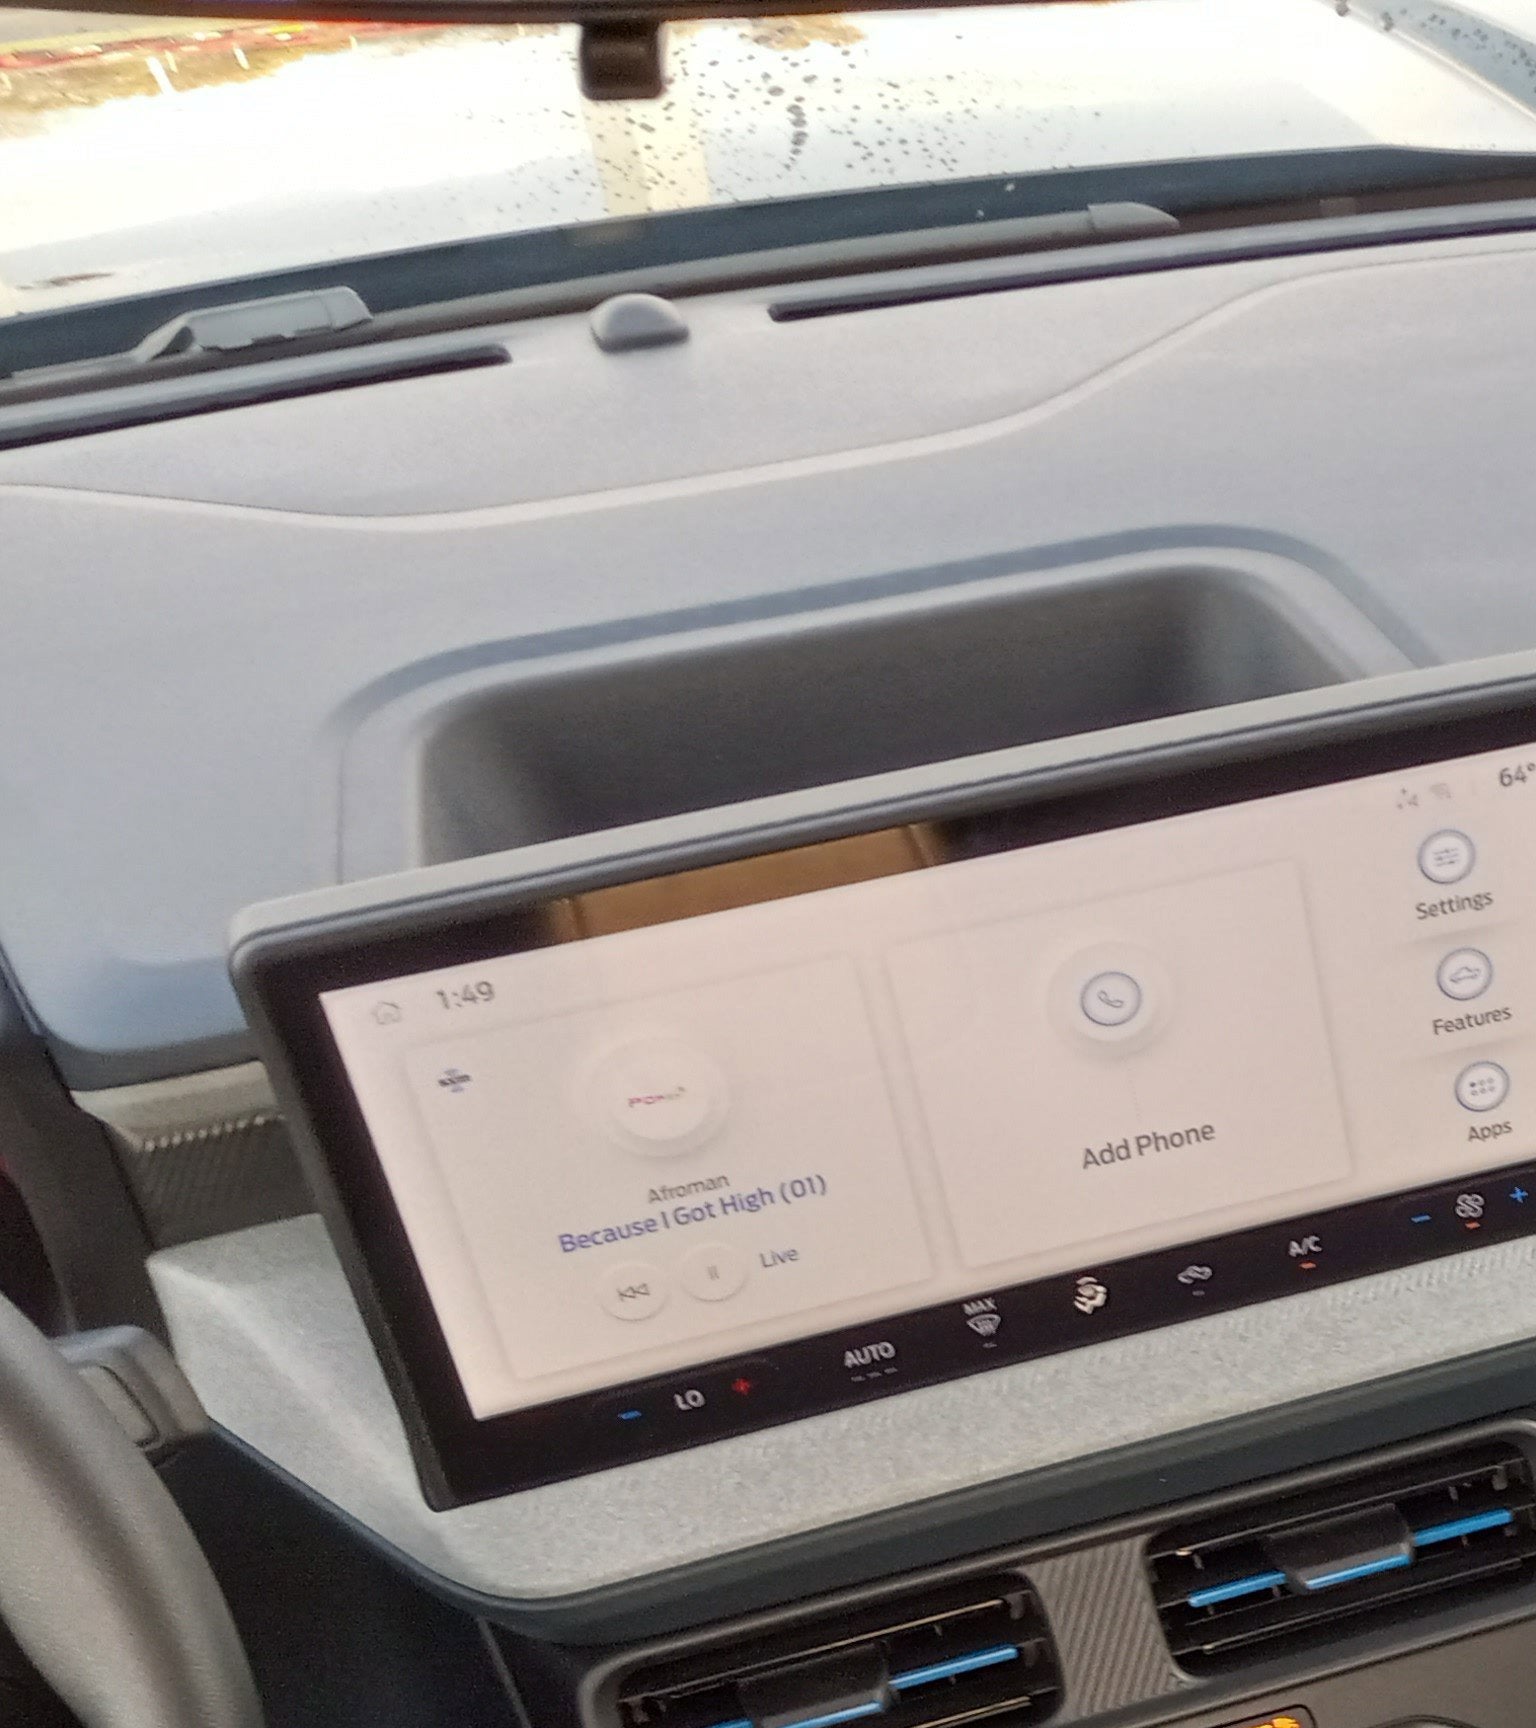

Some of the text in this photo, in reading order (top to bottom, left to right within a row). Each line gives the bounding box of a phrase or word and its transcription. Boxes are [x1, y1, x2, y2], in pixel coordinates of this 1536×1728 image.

[1416, 892, 1494, 920] Settings
[436, 981, 495, 1009] 1:49
[1432, 1007, 1512, 1035] Features
[1468, 1120, 1513, 1142] Apps
[1083, 1124, 1215, 1169] Add Phone
[648, 1175, 730, 1204] Afroman
[558, 1217, 658, 1252] Because
[662, 1211, 671, 1229] I
[674, 1202, 716, 1228] Got
[720, 1187, 775, 1215] High
[759, 1247, 799, 1268] Live
[1288, 1235, 1322, 1257] A/C
[963, 1298, 997, 1316] MAX
[844, 1341, 897, 1369] AUTO
[673, 1389, 706, 1411] LO
